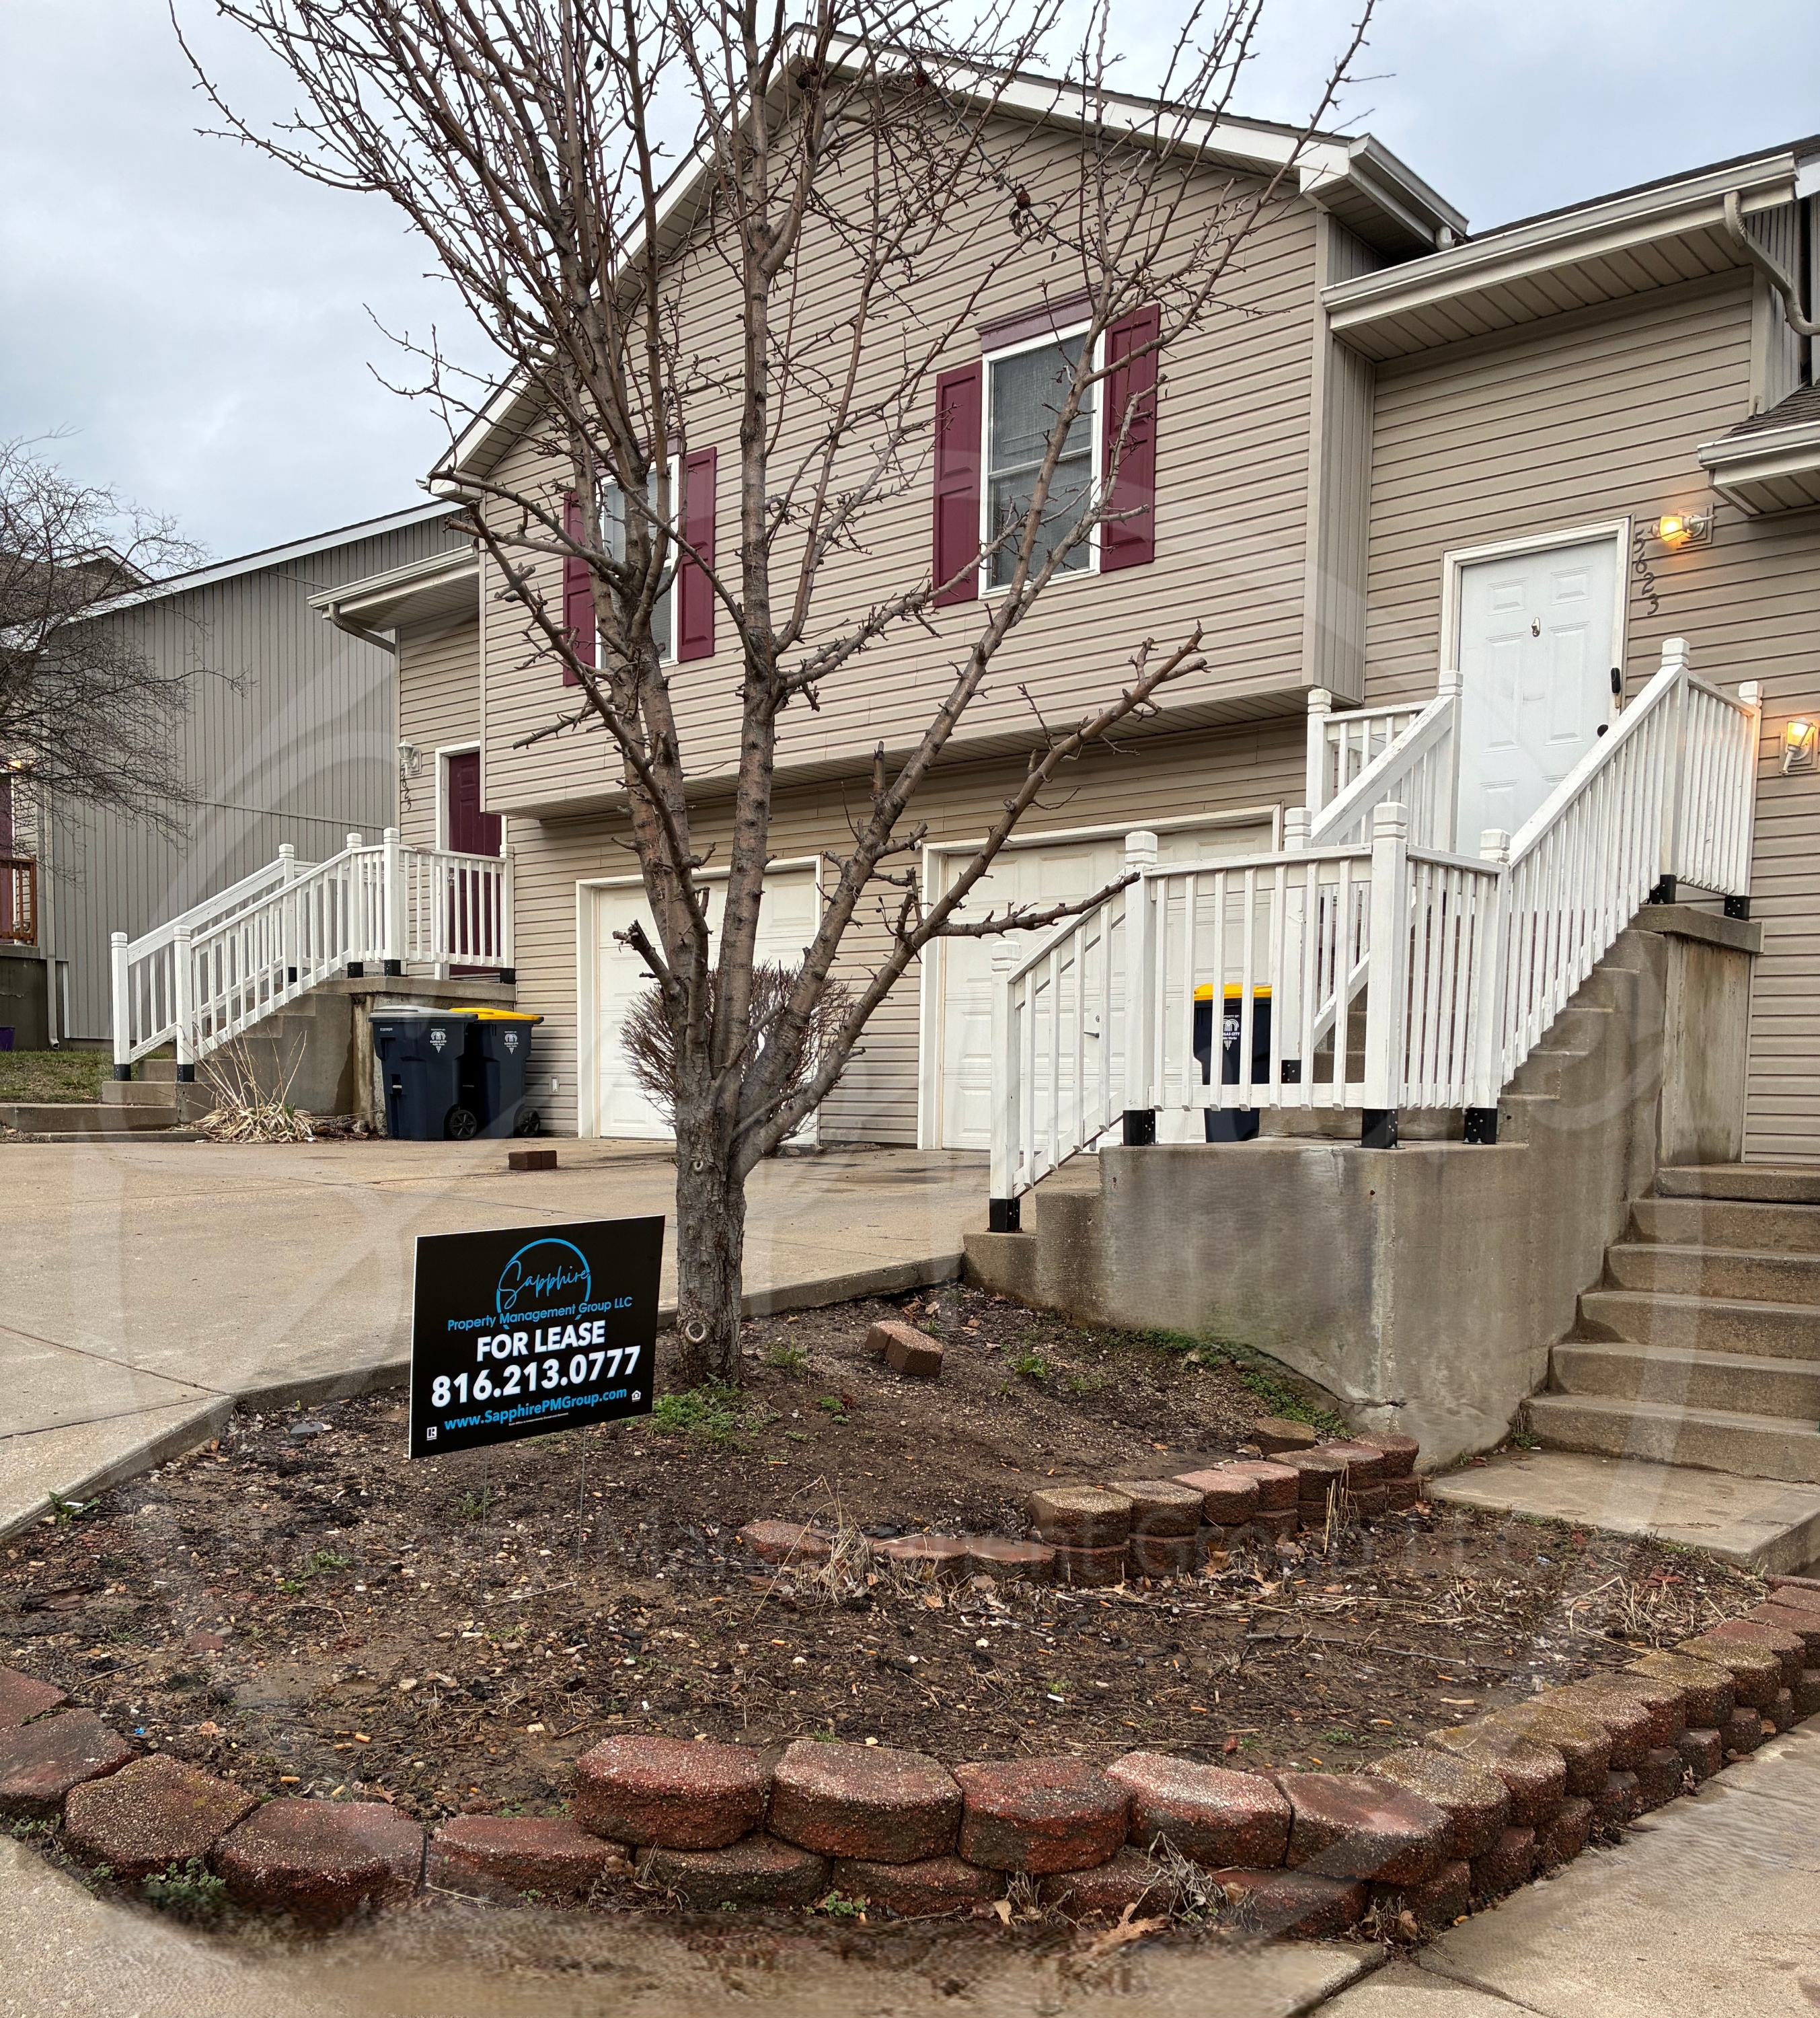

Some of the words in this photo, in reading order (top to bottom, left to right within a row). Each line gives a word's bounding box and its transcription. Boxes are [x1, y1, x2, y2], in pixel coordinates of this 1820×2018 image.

[1633, 528, 1660, 616] 5623
[498, 1260, 590, 1310] Sapphire
[447, 1315, 496, 1331] Property
[499, 1305, 576, 1324] Management
[578, 1300, 612, 1314] Group
[614, 1296, 633, 1309] LLC
[476, 1331, 529, 1362] FOR
[534, 1320, 607, 1353] LEASE
[431, 1345, 642, 1407] 816.213.0777
[444, 1388, 628, 1431] www.SapphirePMGroup.com
